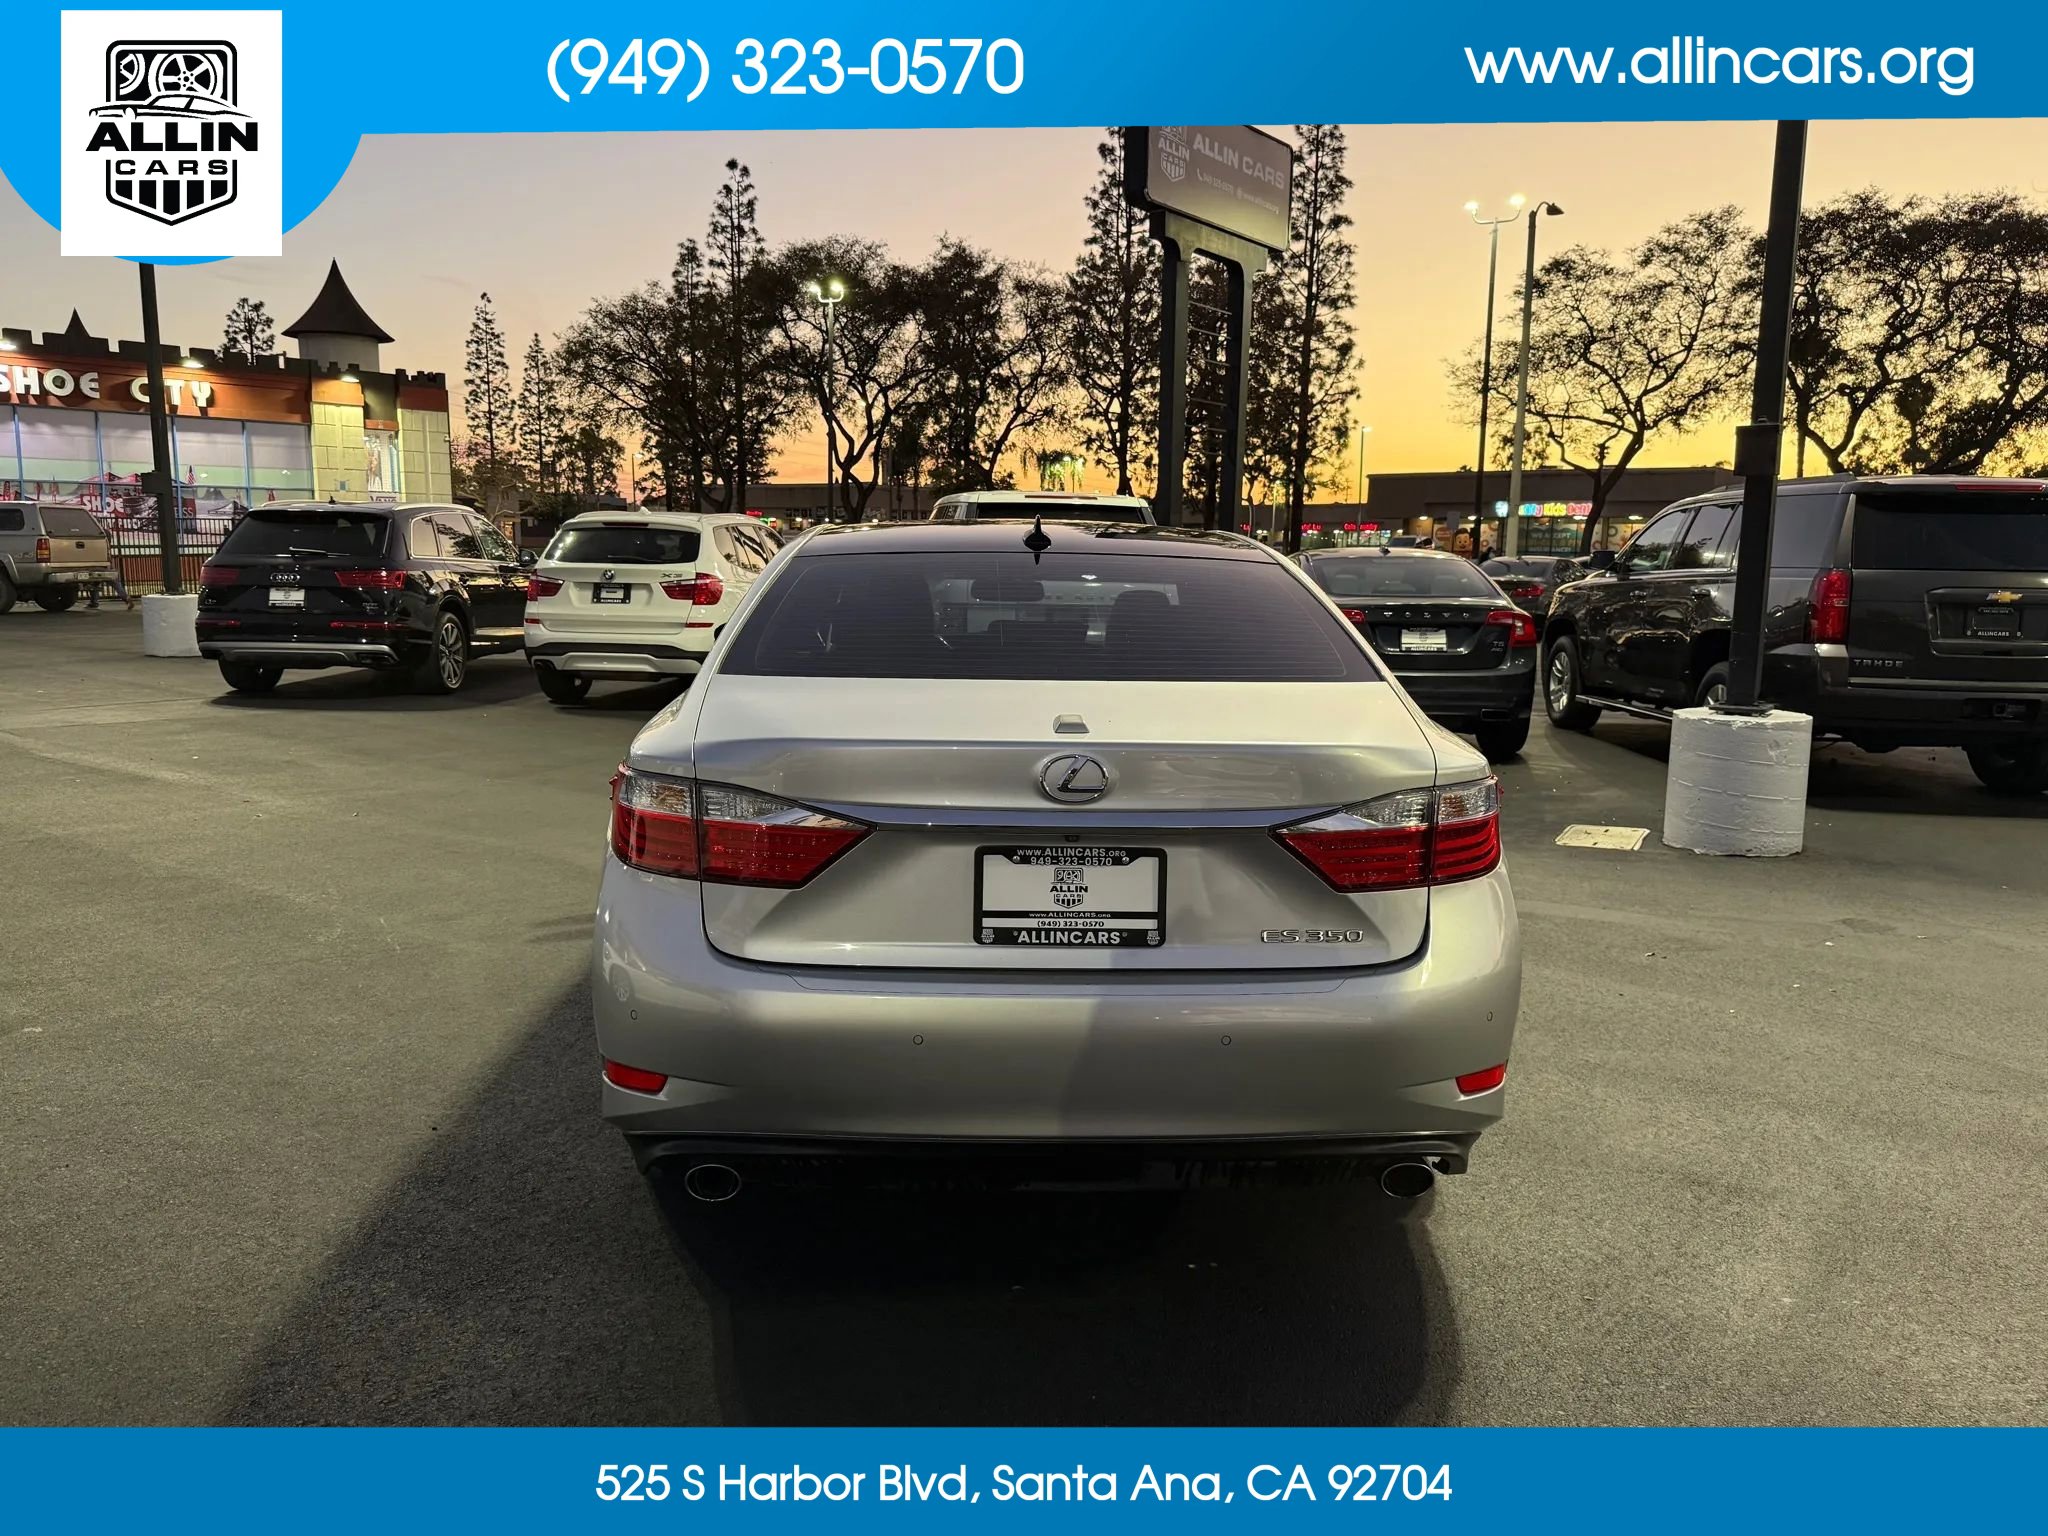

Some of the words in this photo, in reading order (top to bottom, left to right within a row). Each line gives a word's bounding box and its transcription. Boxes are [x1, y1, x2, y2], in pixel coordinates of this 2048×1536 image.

[1158, 137, 1190, 162] ALLIN
[1193, 134, 1239, 169] ALLIN
[1243, 156, 1285, 190] CARS
[130, 376, 212, 407] CTY
[82, 495, 125, 513] SHOE
[1854, 658, 1903, 668] TAHOE
[1031, 857, 1112, 866] 949-323-0570
[1050, 885, 1088, 893] ALLIN
[1062, 920, 1104, 928] 323-0570
[1018, 930, 1121, 944] ALLINCARS
[1261, 929, 1299, 943] ES
[1305, 929, 1363, 943] 350
